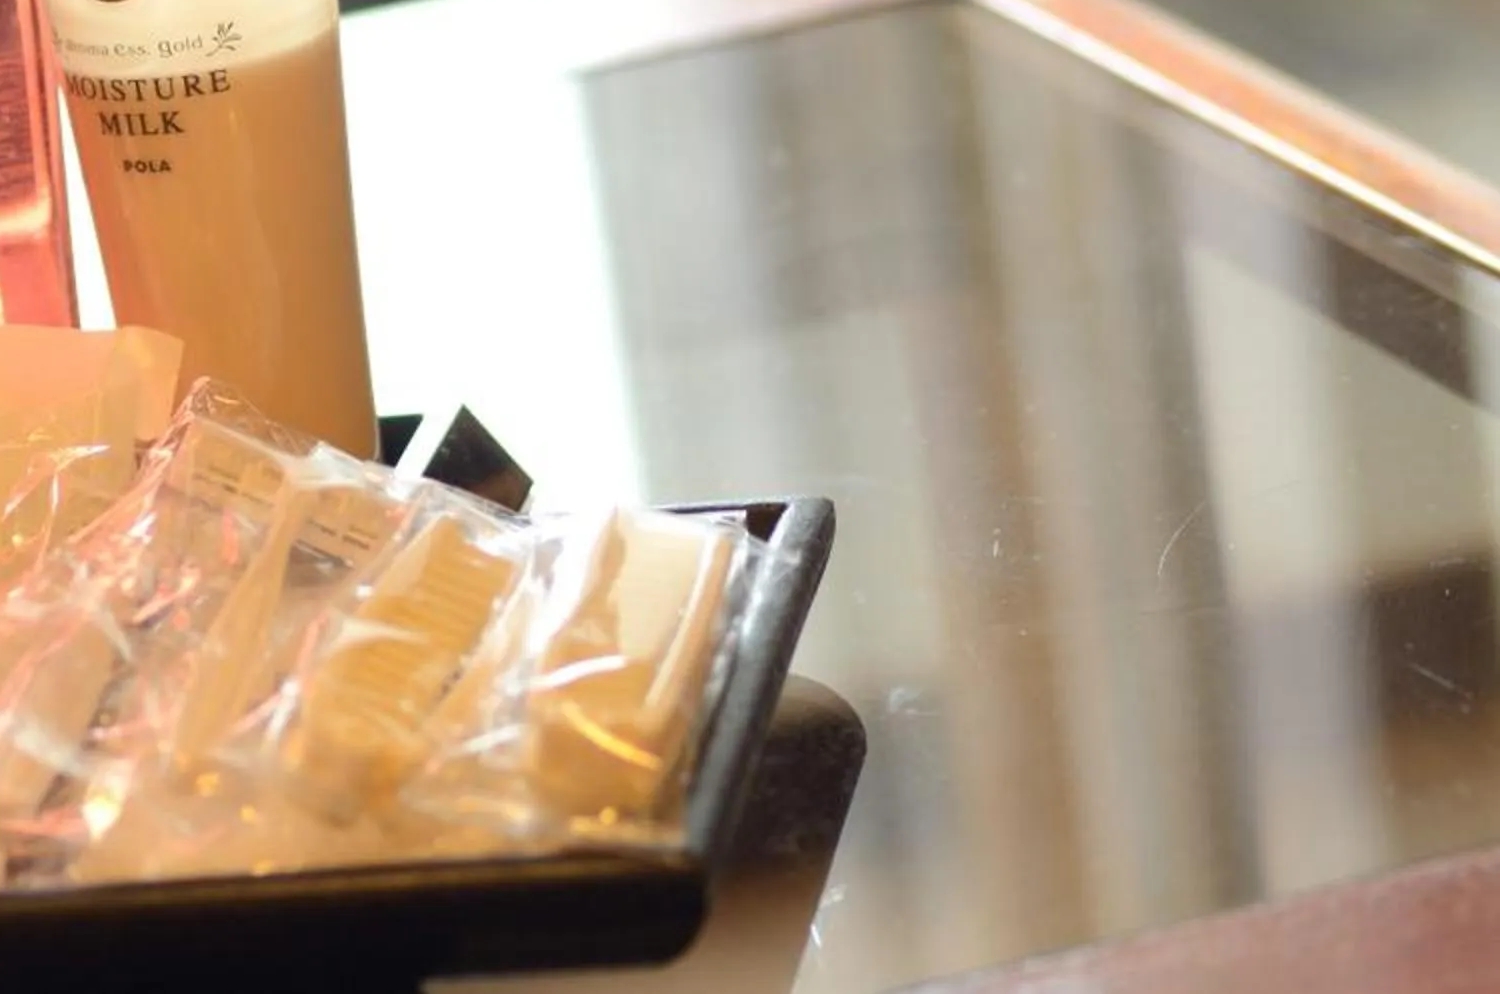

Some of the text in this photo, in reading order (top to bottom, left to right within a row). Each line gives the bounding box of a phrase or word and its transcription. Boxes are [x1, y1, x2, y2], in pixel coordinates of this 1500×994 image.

[156, 34, 204, 59] gold
[66, 68, 233, 103] MOISTURE
[96, 109, 186, 138] MILK
[121, 157, 173, 175] POLA
